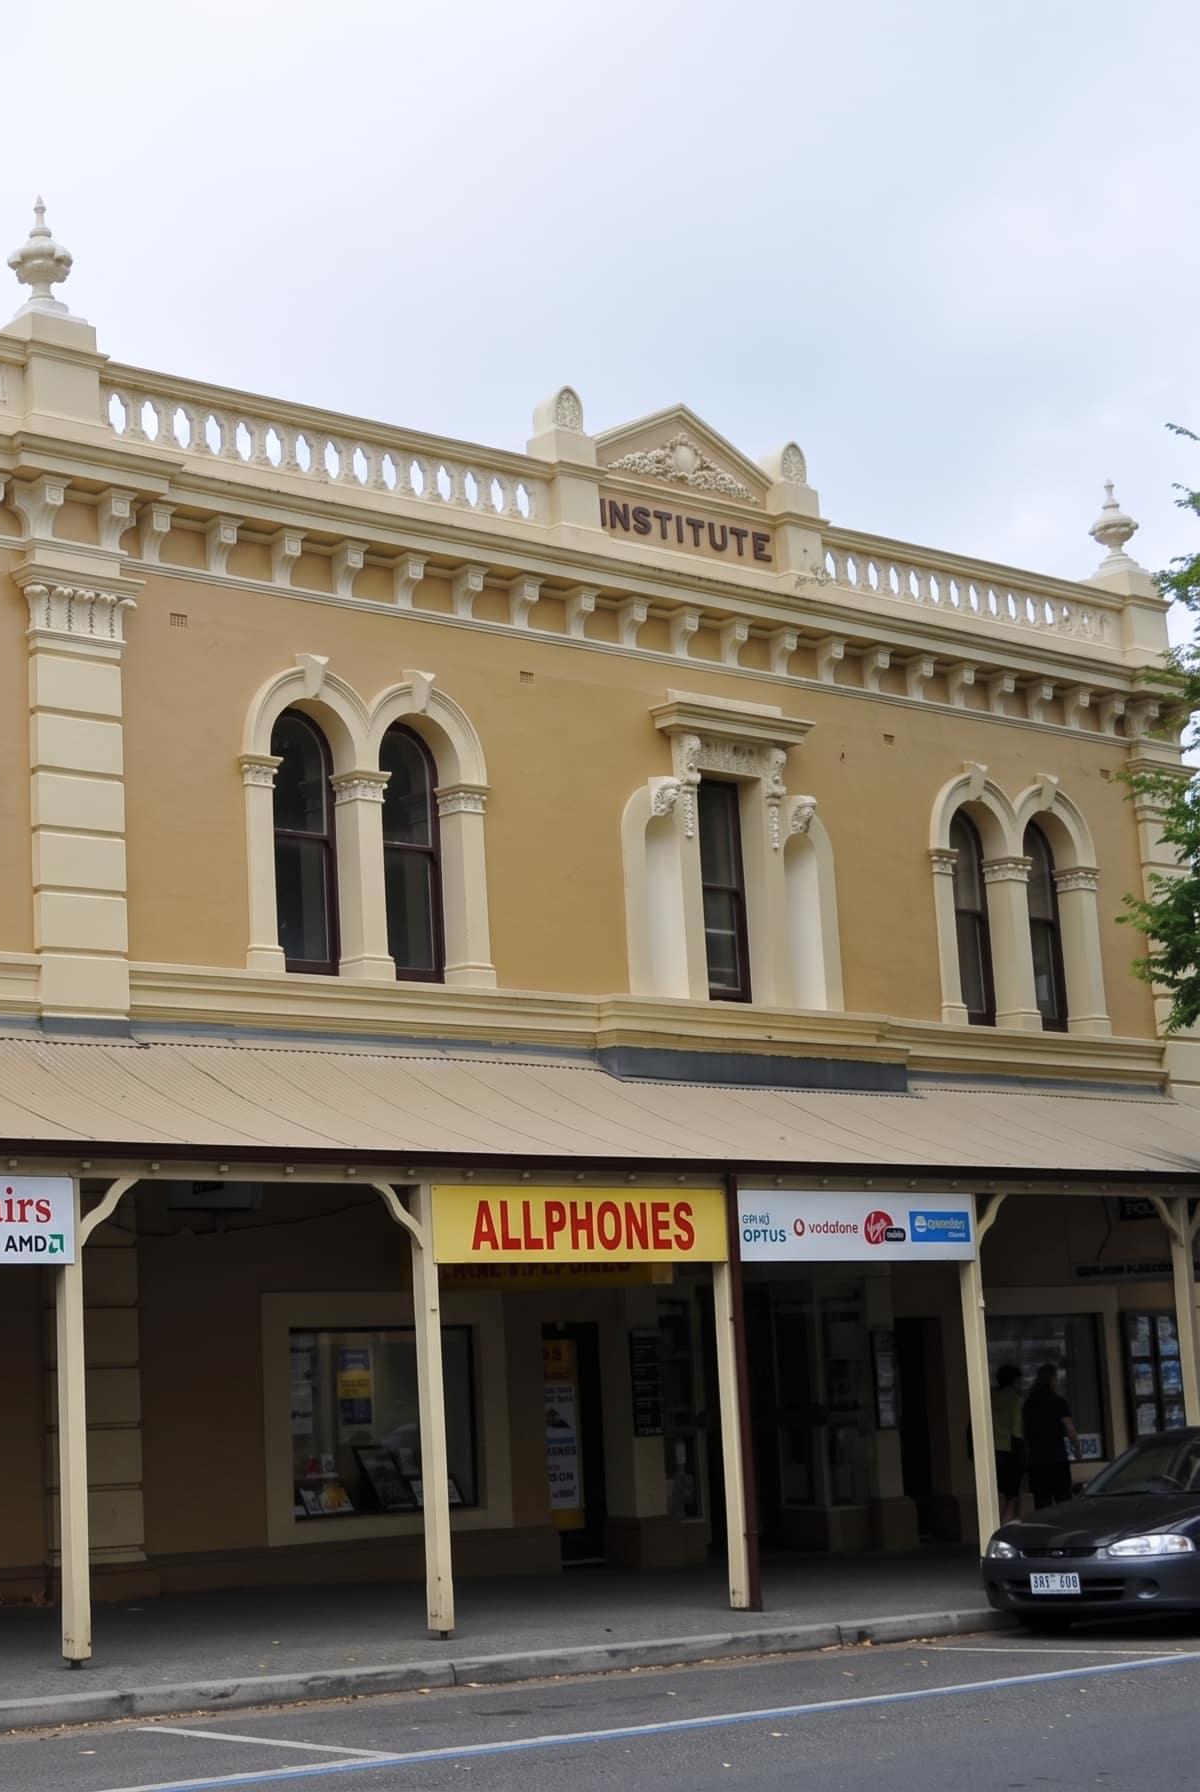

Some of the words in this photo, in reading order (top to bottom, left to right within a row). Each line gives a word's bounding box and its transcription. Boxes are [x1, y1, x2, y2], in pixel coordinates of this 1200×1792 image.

[600, 498, 772, 562] INSTITUTE
[471, 1199, 696, 1251] ALLPHONES
[808, 1221, 859, 1234] vodafone
[4, 1235, 47, 1252] AMD
[743, 1229, 787, 1242] OPTUS
